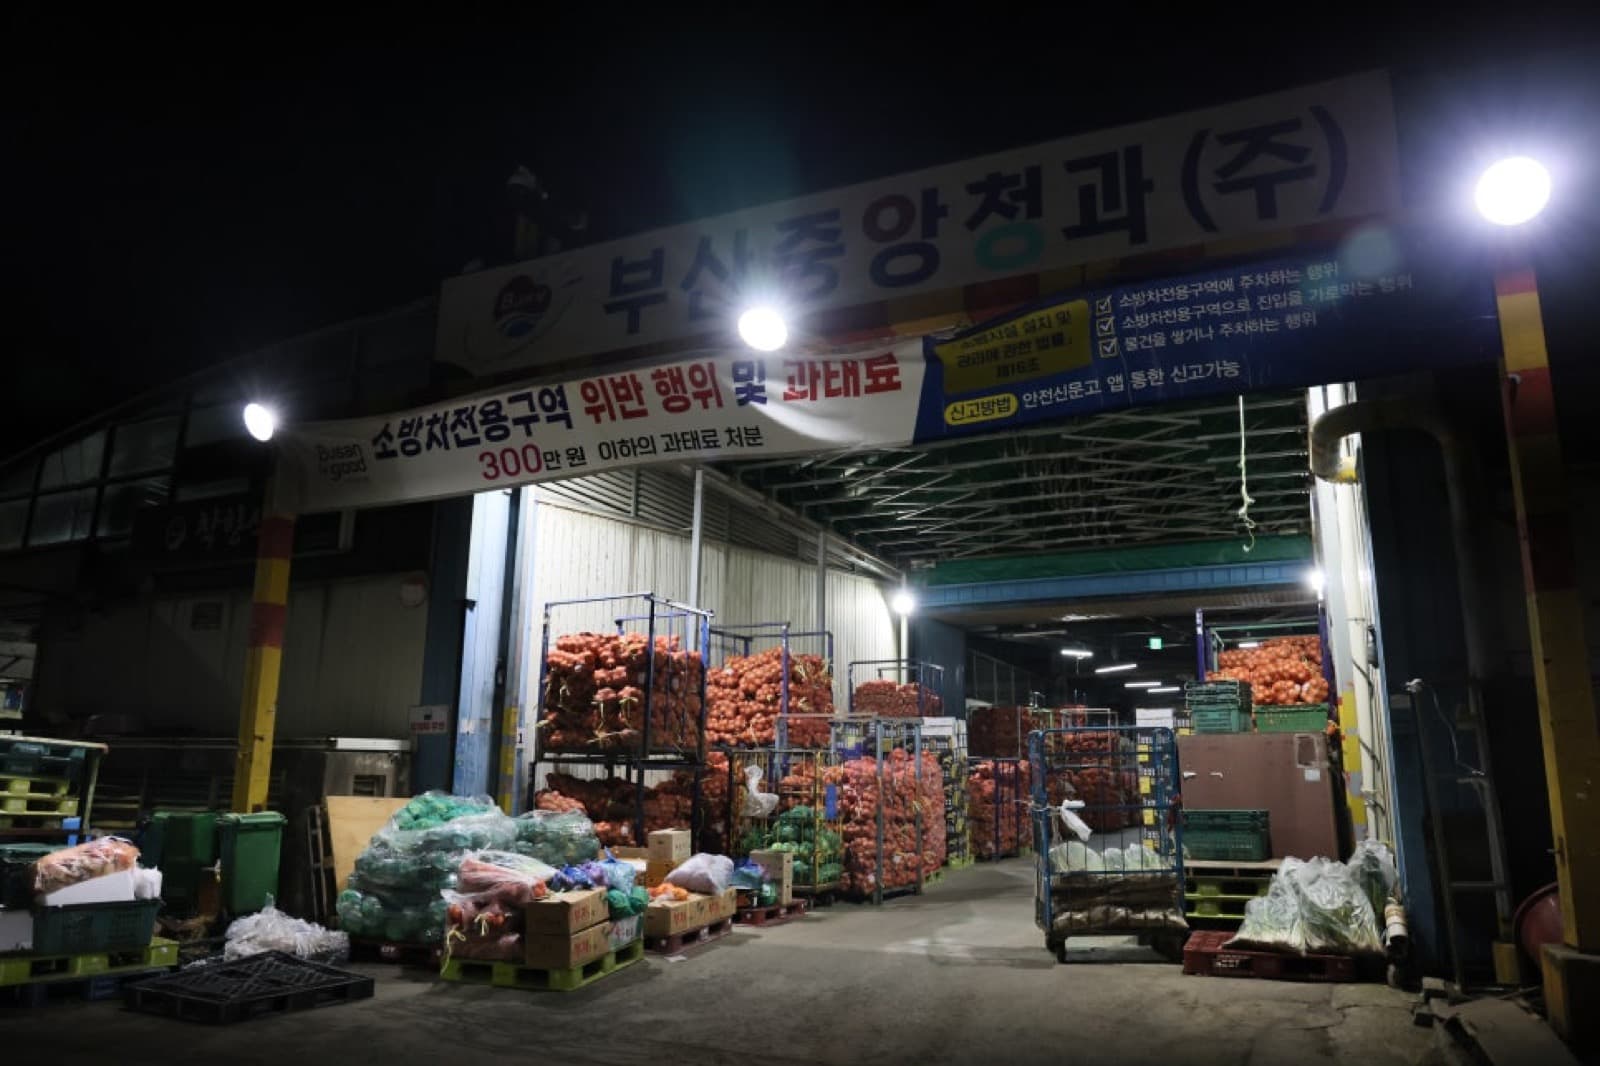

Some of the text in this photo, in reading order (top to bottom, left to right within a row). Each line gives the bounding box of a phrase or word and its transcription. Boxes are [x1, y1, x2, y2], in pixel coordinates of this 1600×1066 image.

[1119, 277, 1235, 308] 소방차전용구역에
[1240, 269, 1302, 289] 주차하는
[1121, 299, 1251, 330] 소방차전용구역으로
[1219, 315, 1280, 338] 주차하는
[1285, 311, 1317, 331] 행위
[1021, 358, 1241, 409] 안전신문고 앱 통한 신고가능
[371, 351, 902, 460] 소방차전용구역 위반 행위 및 과태료
[950, 395, 1011, 421] 신고방법
[598, 437, 657, 461] 이하의
[663, 429, 722, 455] 과태료
[726, 424, 763, 449] 처분
